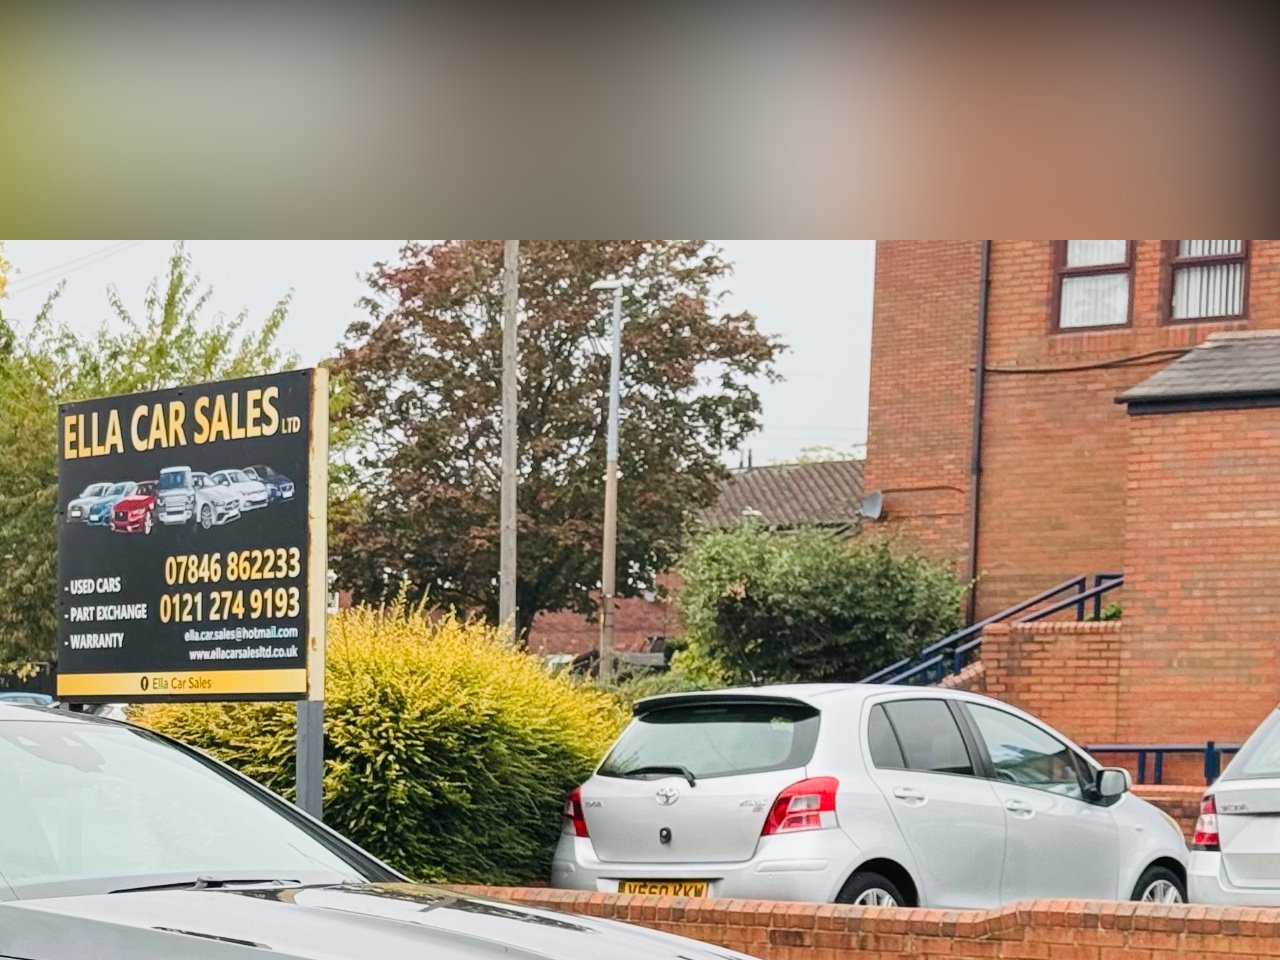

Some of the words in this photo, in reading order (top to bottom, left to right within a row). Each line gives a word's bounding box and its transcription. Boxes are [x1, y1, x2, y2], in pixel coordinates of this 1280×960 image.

[64, 409, 124, 460] ELLA
[130, 400, 187, 452] CAR
[193, 386, 279, 444] SALES
[281, 416, 301, 434] LTD
[165, 552, 222, 586] 07846
[226, 546, 301, 582] 862233
[70, 578, 95, 595] USED
[96, 576, 122, 593] CARS
[70, 606, 95, 622] PART
[96, 603, 148, 621] EXCHANGE
[160, 591, 203, 623] 0121
[209, 590, 245, 621] 274
[250, 586, 300, 619] 9193
[69, 632, 125, 650] WARRANTY
[184, 625, 299, 642] ella.car.sales@hotmail.com
[189, 644, 299, 660] www.ellacarsalesltd.co.uk
[152, 677, 169, 690] Ella
[171, 676, 187, 690] Car
[188, 676, 212, 689] Sales
